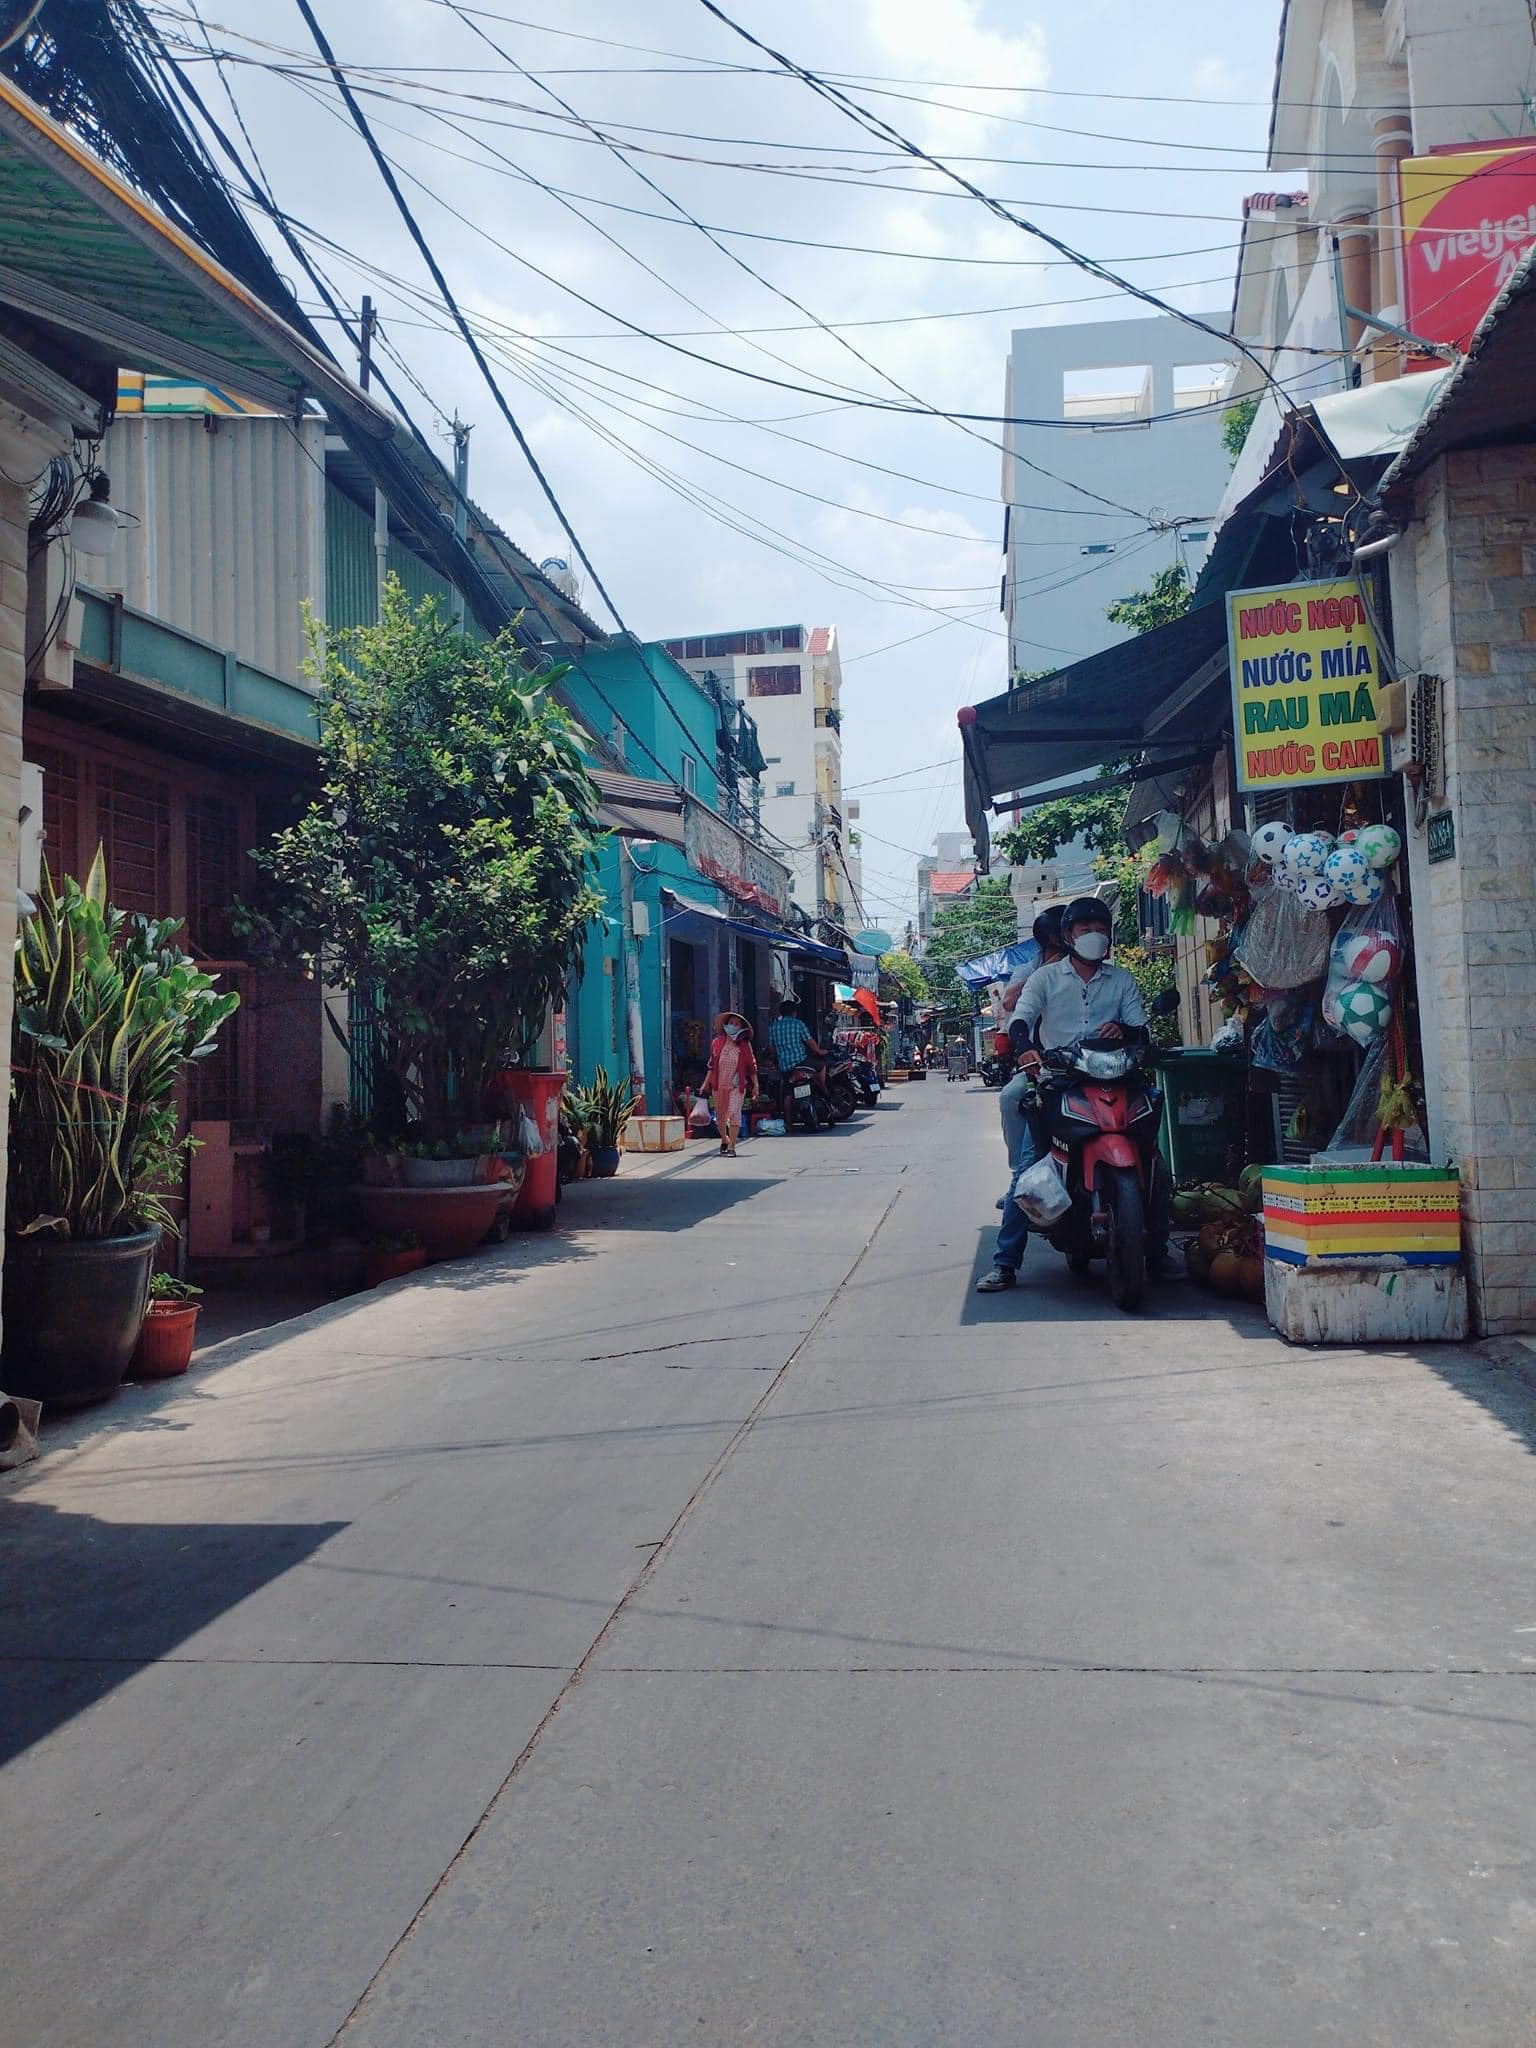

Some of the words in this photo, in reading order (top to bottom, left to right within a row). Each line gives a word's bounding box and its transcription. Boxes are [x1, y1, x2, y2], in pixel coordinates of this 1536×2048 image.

[1239, 598, 1302, 640] NƯỚC
[1242, 648, 1312, 688] NƯỚC
[1321, 641, 1373, 679] MÍA
[1243, 695, 1310, 735] RAU
[1318, 682, 1377, 727] MÁ
[1247, 740, 1316, 779] NƯỚC
[1321, 737, 1380, 771] CAM
